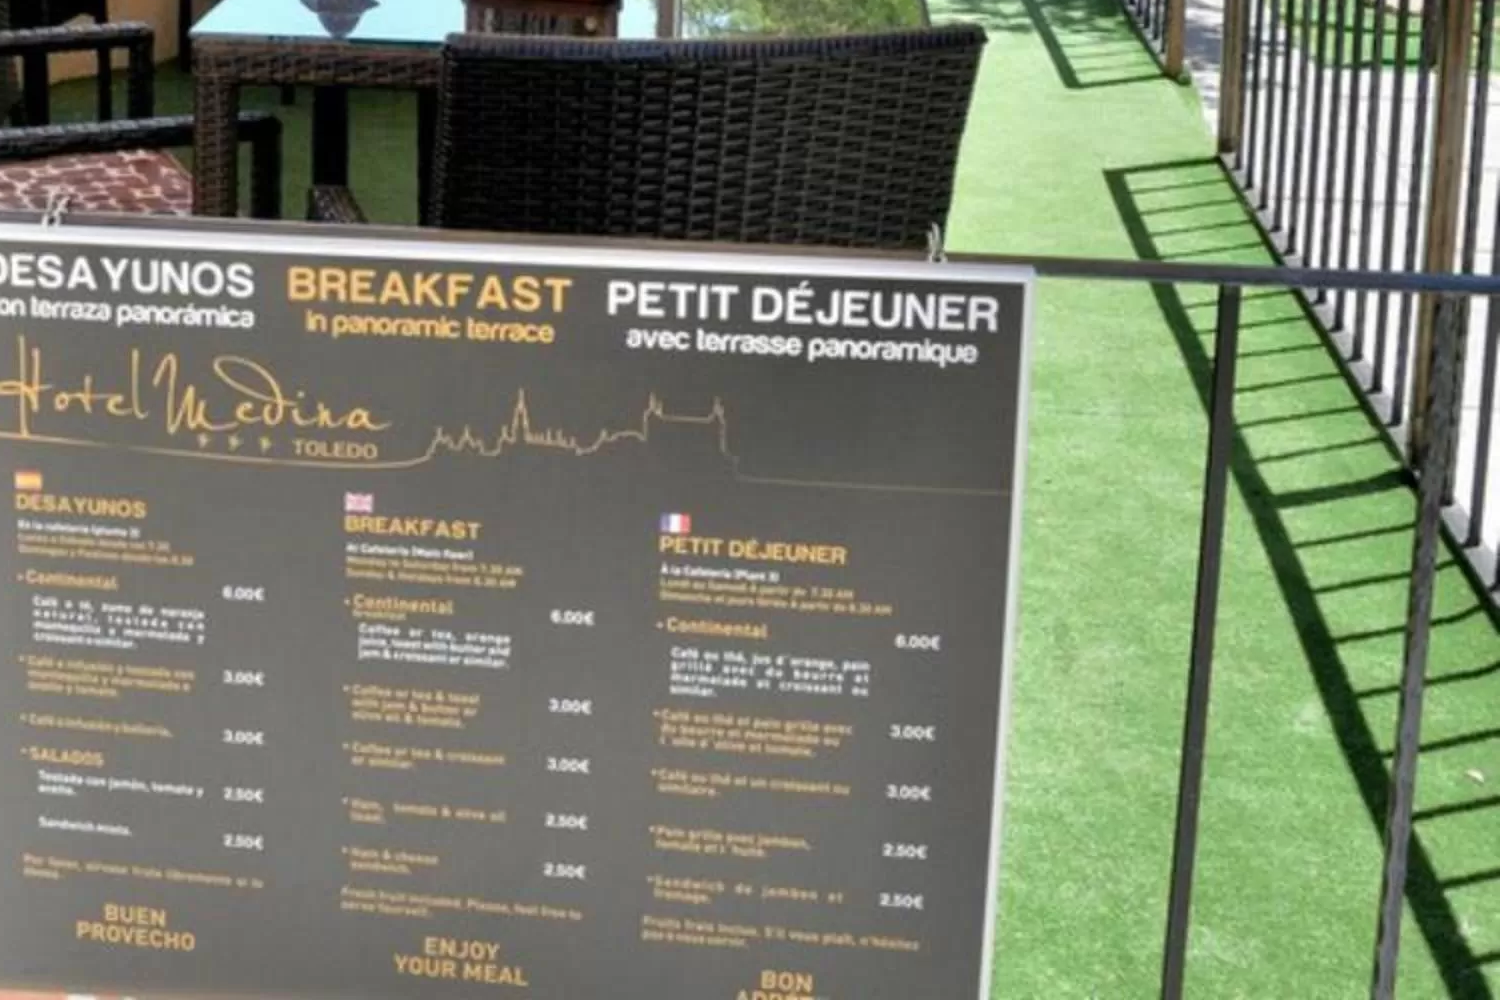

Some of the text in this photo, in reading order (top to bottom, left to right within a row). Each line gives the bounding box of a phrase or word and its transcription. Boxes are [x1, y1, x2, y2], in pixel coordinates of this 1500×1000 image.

[287, 267, 572, 312] BREAKFAST
[31, 296, 111, 321] terraza
[116, 303, 254, 328] panorámica
[607, 281, 999, 333] PETIT DÉJEUNER
[306, 310, 554, 343] in panoramic terrace
[626, 327, 979, 368] avec terrasse panoramique
[153, 352, 390, 435] Medina
[293, 439, 378, 459] TOLEDO
[15, 494, 147, 518] DESAYUNOS
[344, 515, 484, 540] BREAKFAST
[659, 536, 724, 557] PETIT
[354, 593, 453, 615] Continental
[550, 609, 594, 626] 6.00€
[667, 617, 768, 639] Continental
[895, 633, 941, 651] 6.00€
[223, 670, 265, 687] 3.00€
[548, 698, 592, 714] 3.00€
[222, 729, 264, 745] 3.00€
[889, 724, 936, 741] 3.00€
[547, 757, 590, 773] 3.00€
[223, 787, 264, 803] 2.50€
[886, 784, 932, 801] 3.00€
[545, 812, 588, 830] 2.50€
[223, 834, 264, 850] 2.50€
[883, 843, 928, 860] 2.50€
[543, 862, 586, 880] 2.50€
[880, 892, 924, 910] 2.50€
[105, 903, 166, 927] BUEN
[76, 921, 195, 951] PROVECHO
[424, 936, 500, 961] ENJOY
[393, 955, 528, 986] YOUR MEAL
[761, 970, 814, 992] BON
